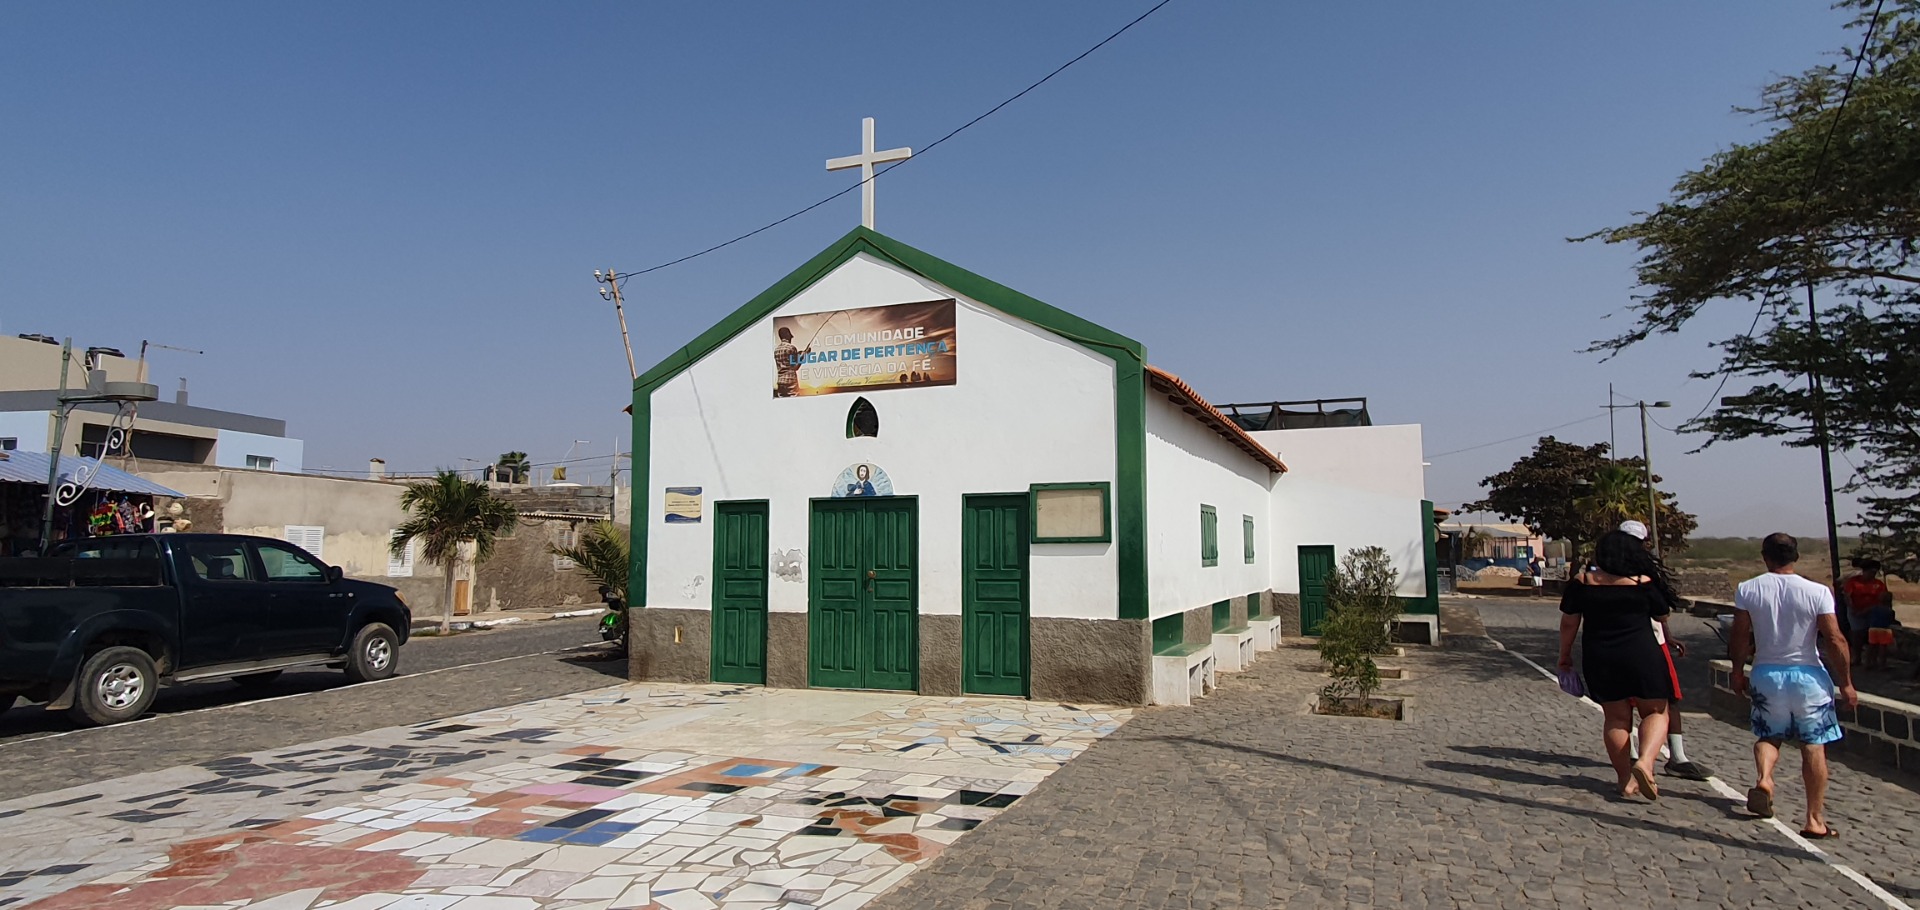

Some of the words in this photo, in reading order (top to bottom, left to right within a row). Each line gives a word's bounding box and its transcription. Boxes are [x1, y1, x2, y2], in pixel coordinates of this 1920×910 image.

[812, 338, 821, 348] A
[825, 327, 924, 347] COMUNIDADE
[789, 350, 837, 365] LUGAR
[841, 348, 860, 361] DE
[864, 340, 948, 358] PERTENÇA
[801, 369, 809, 380] E
[813, 363, 882, 379] VIVÊNCIA
[887, 361, 908, 373] DA
[912, 355, 936, 371] FÉ.
